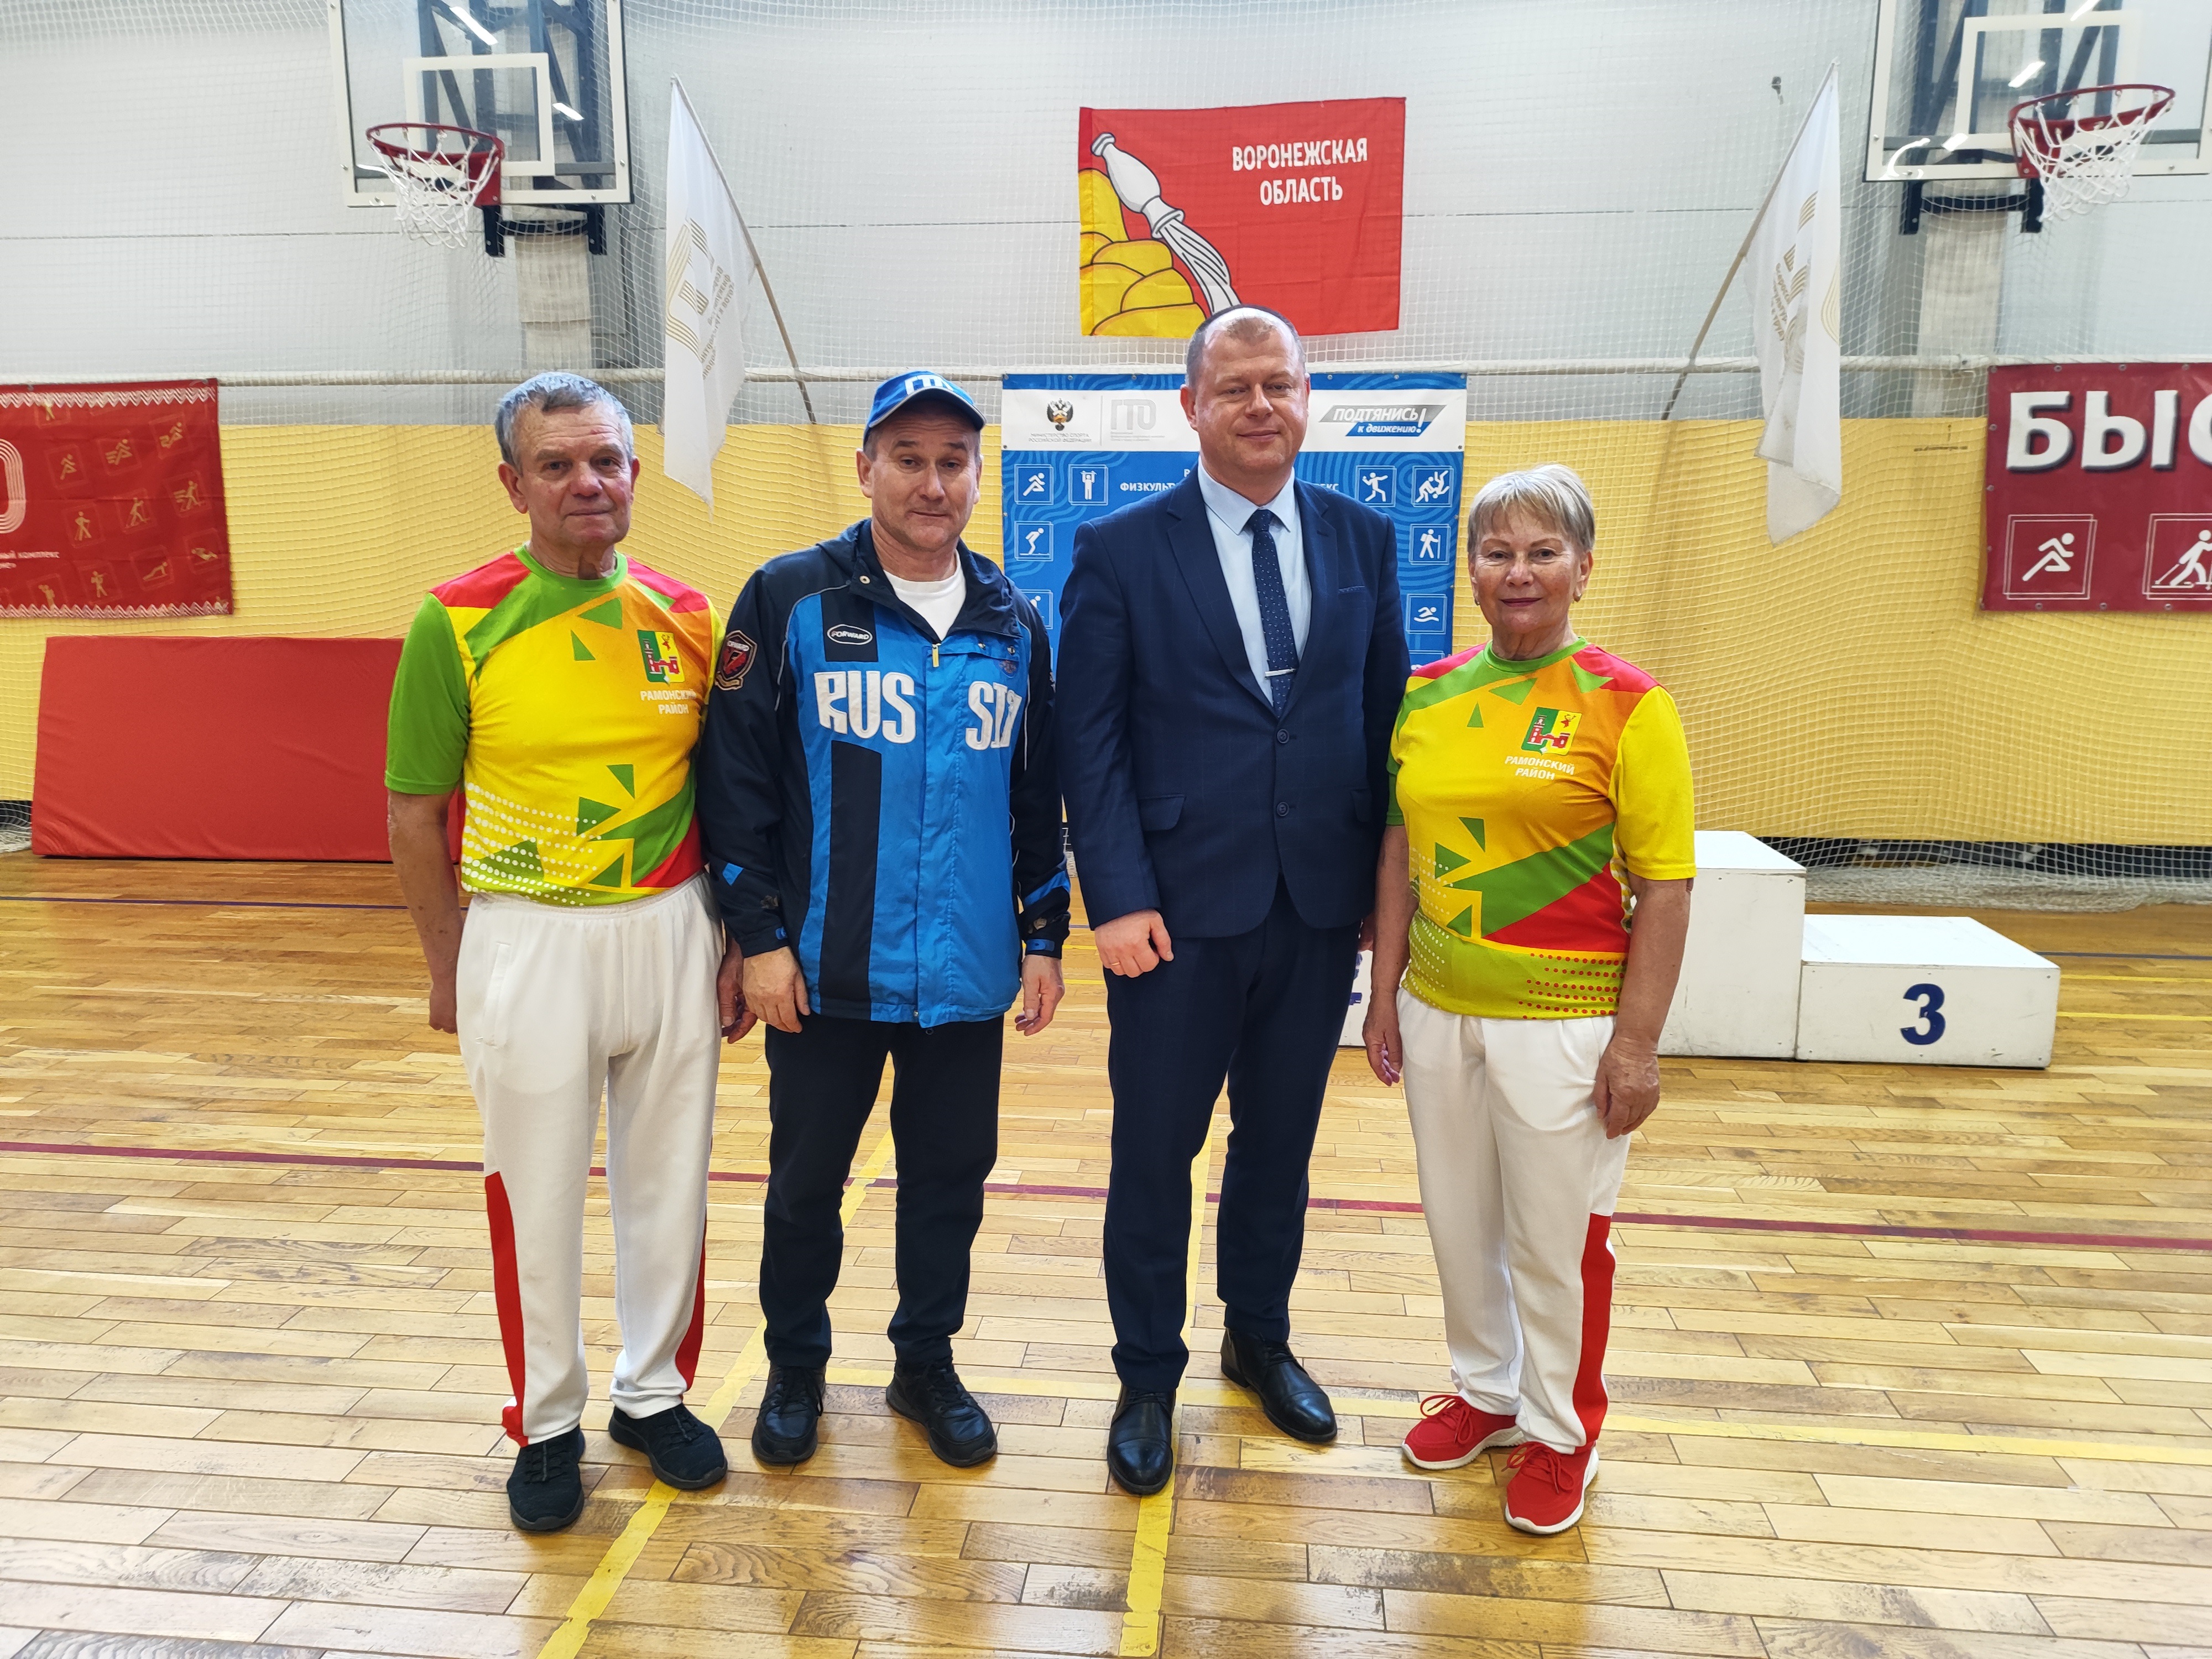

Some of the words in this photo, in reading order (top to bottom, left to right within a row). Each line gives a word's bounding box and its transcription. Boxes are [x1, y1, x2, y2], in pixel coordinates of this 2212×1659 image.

[1232, 137, 1368, 171] ВОРОНЕЖСКАЯ
[1260, 176, 1343, 205] ОБЛАСТЬ
[1111, 399, 1156, 430] ГТО
[1120, 482, 1177, 492] ФИЗКУЛЬТ
[658, 702, 689, 714] РАЙОН
[1505, 755, 1575, 775] РАМОНСКИЙ
[1515, 767, 1555, 780] РАЙОН
[1899, 983, 1946, 1045] 3
